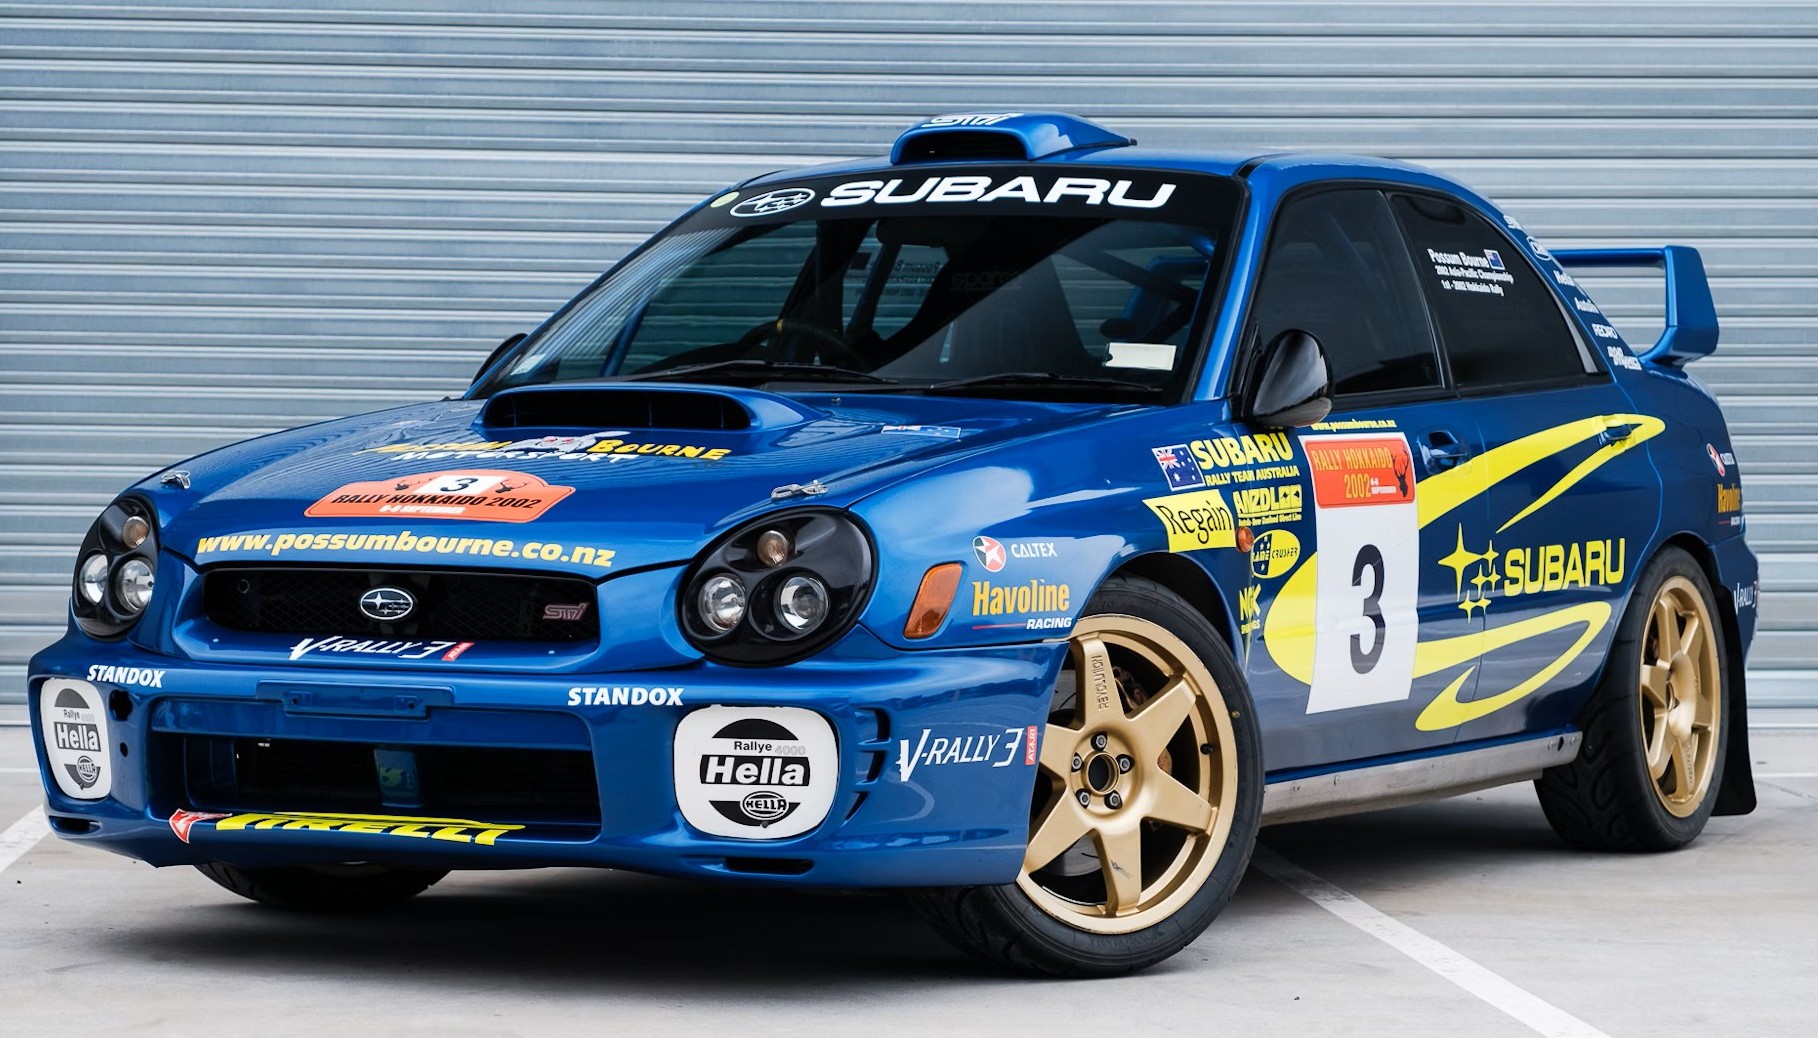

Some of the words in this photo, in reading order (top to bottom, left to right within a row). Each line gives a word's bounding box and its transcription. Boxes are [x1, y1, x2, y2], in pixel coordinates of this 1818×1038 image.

[821, 176, 1177, 208] SUBARU
[1427, 248, 1462, 265] Possum
[1459, 252, 1490, 268] Bourne
[1190, 432, 1294, 470] SUBARU
[1311, 450, 1343, 472] RALLY
[1343, 446, 1394, 470] HOKKAIDO
[440, 477, 479, 492] 3
[1204, 472, 1231, 486] RALLY
[1231, 470, 1256, 483] TEAM
[1256, 465, 1300, 480] AUSTRALIA
[1343, 473, 1372, 499] 2002
[331, 494, 388, 506] RALLY
[387, 494, 484, 508] HOKKAIDO
[484, 496, 542, 510] 2002
[1156, 502, 1233, 545] Regain
[197, 531, 616, 567] www.possumbourne.co.nz
[1011, 543, 1058, 558] CALTEX
[1504, 537, 1625, 596] SUBARU
[972, 579, 1070, 616] Havoline
[1350, 543, 1386, 674] 3
[1026, 617, 1072, 629] RACING
[288, 635, 423, 660] V-RALLY
[397, 640, 457, 659] 3
[87, 664, 166, 688] STANDOX
[1091, 655, 1110, 709] REVOLUTION
[568, 687, 684, 706] STANDOX
[63, 709, 80, 720] Rallye
[57, 723, 99, 751] Hella
[734, 741, 772, 753] Rallye
[775, 745, 806, 755] 4000
[1027, 728, 1037, 762] ATARI
[895, 728, 1000, 782] V-RALLY
[992, 727, 1025, 768] 3
[79, 763, 96, 774] HELLA
[705, 756, 805, 786] Hella
[745, 799, 787, 811] HELLA
[215, 811, 525, 846] PIRELLI
